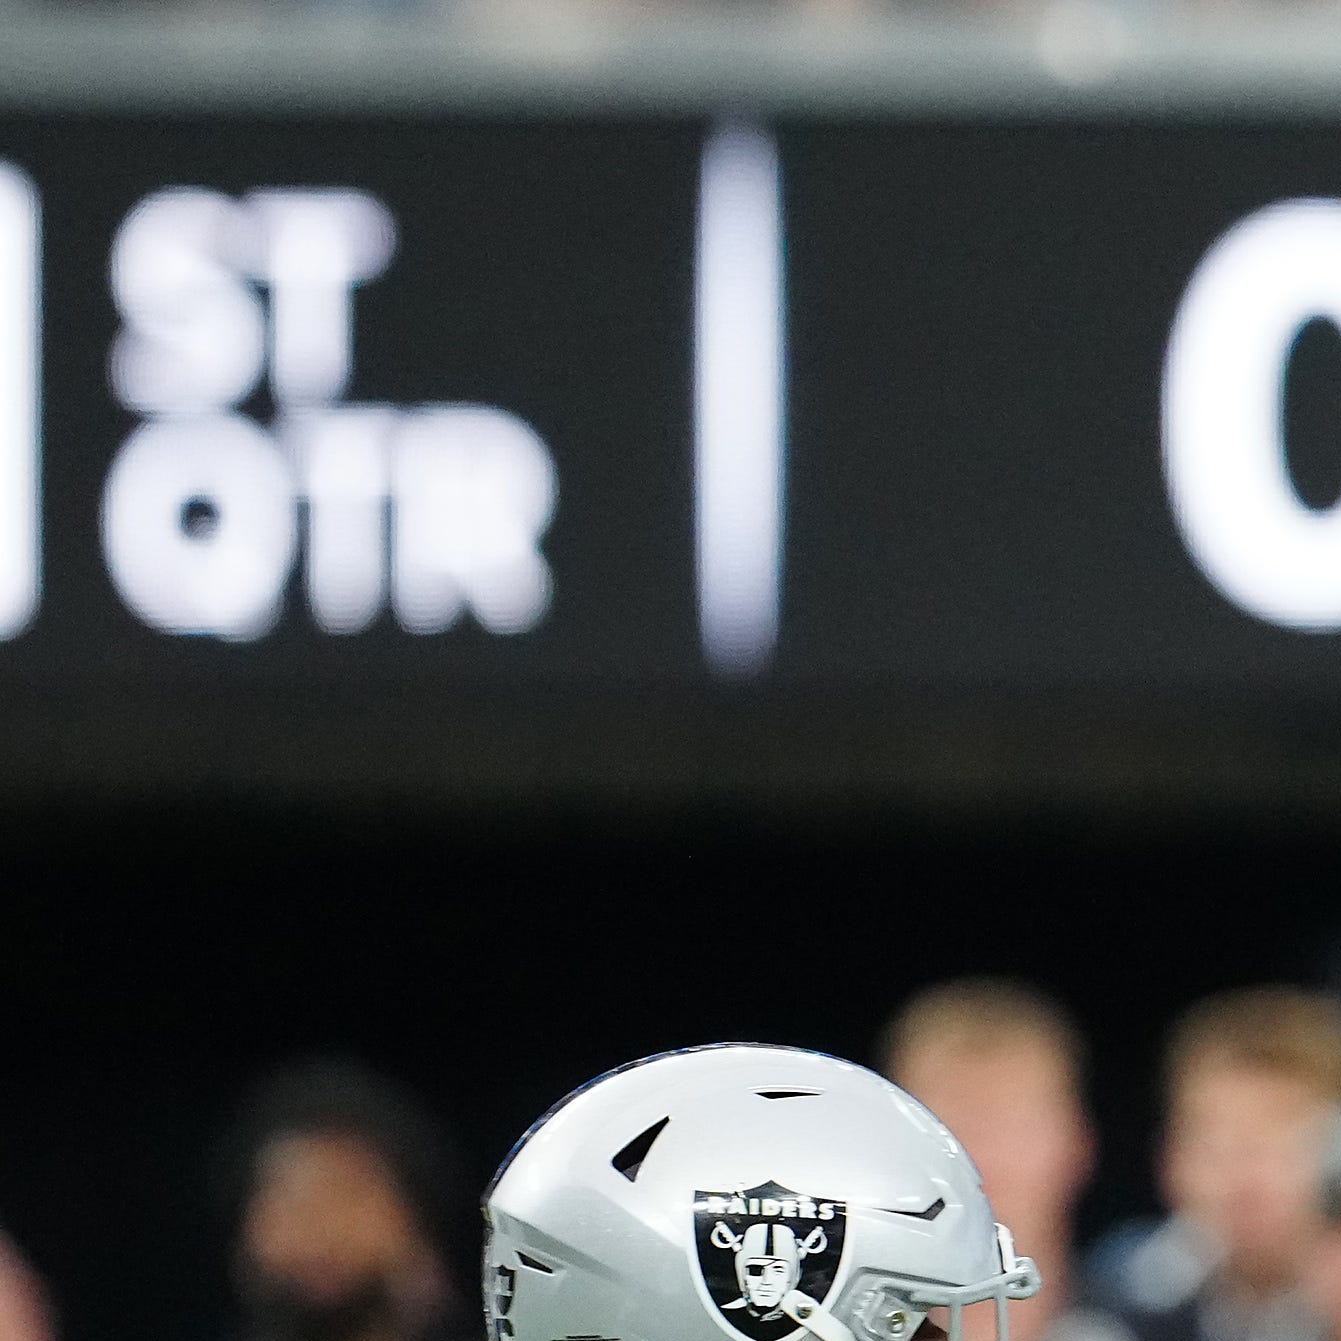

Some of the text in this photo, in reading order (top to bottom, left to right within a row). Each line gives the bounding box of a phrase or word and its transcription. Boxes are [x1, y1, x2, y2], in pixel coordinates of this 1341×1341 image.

[109, 185, 396, 410] ST
[101, 402, 558, 642] QTR
[704, 1196, 836, 1221] RAIDERS
